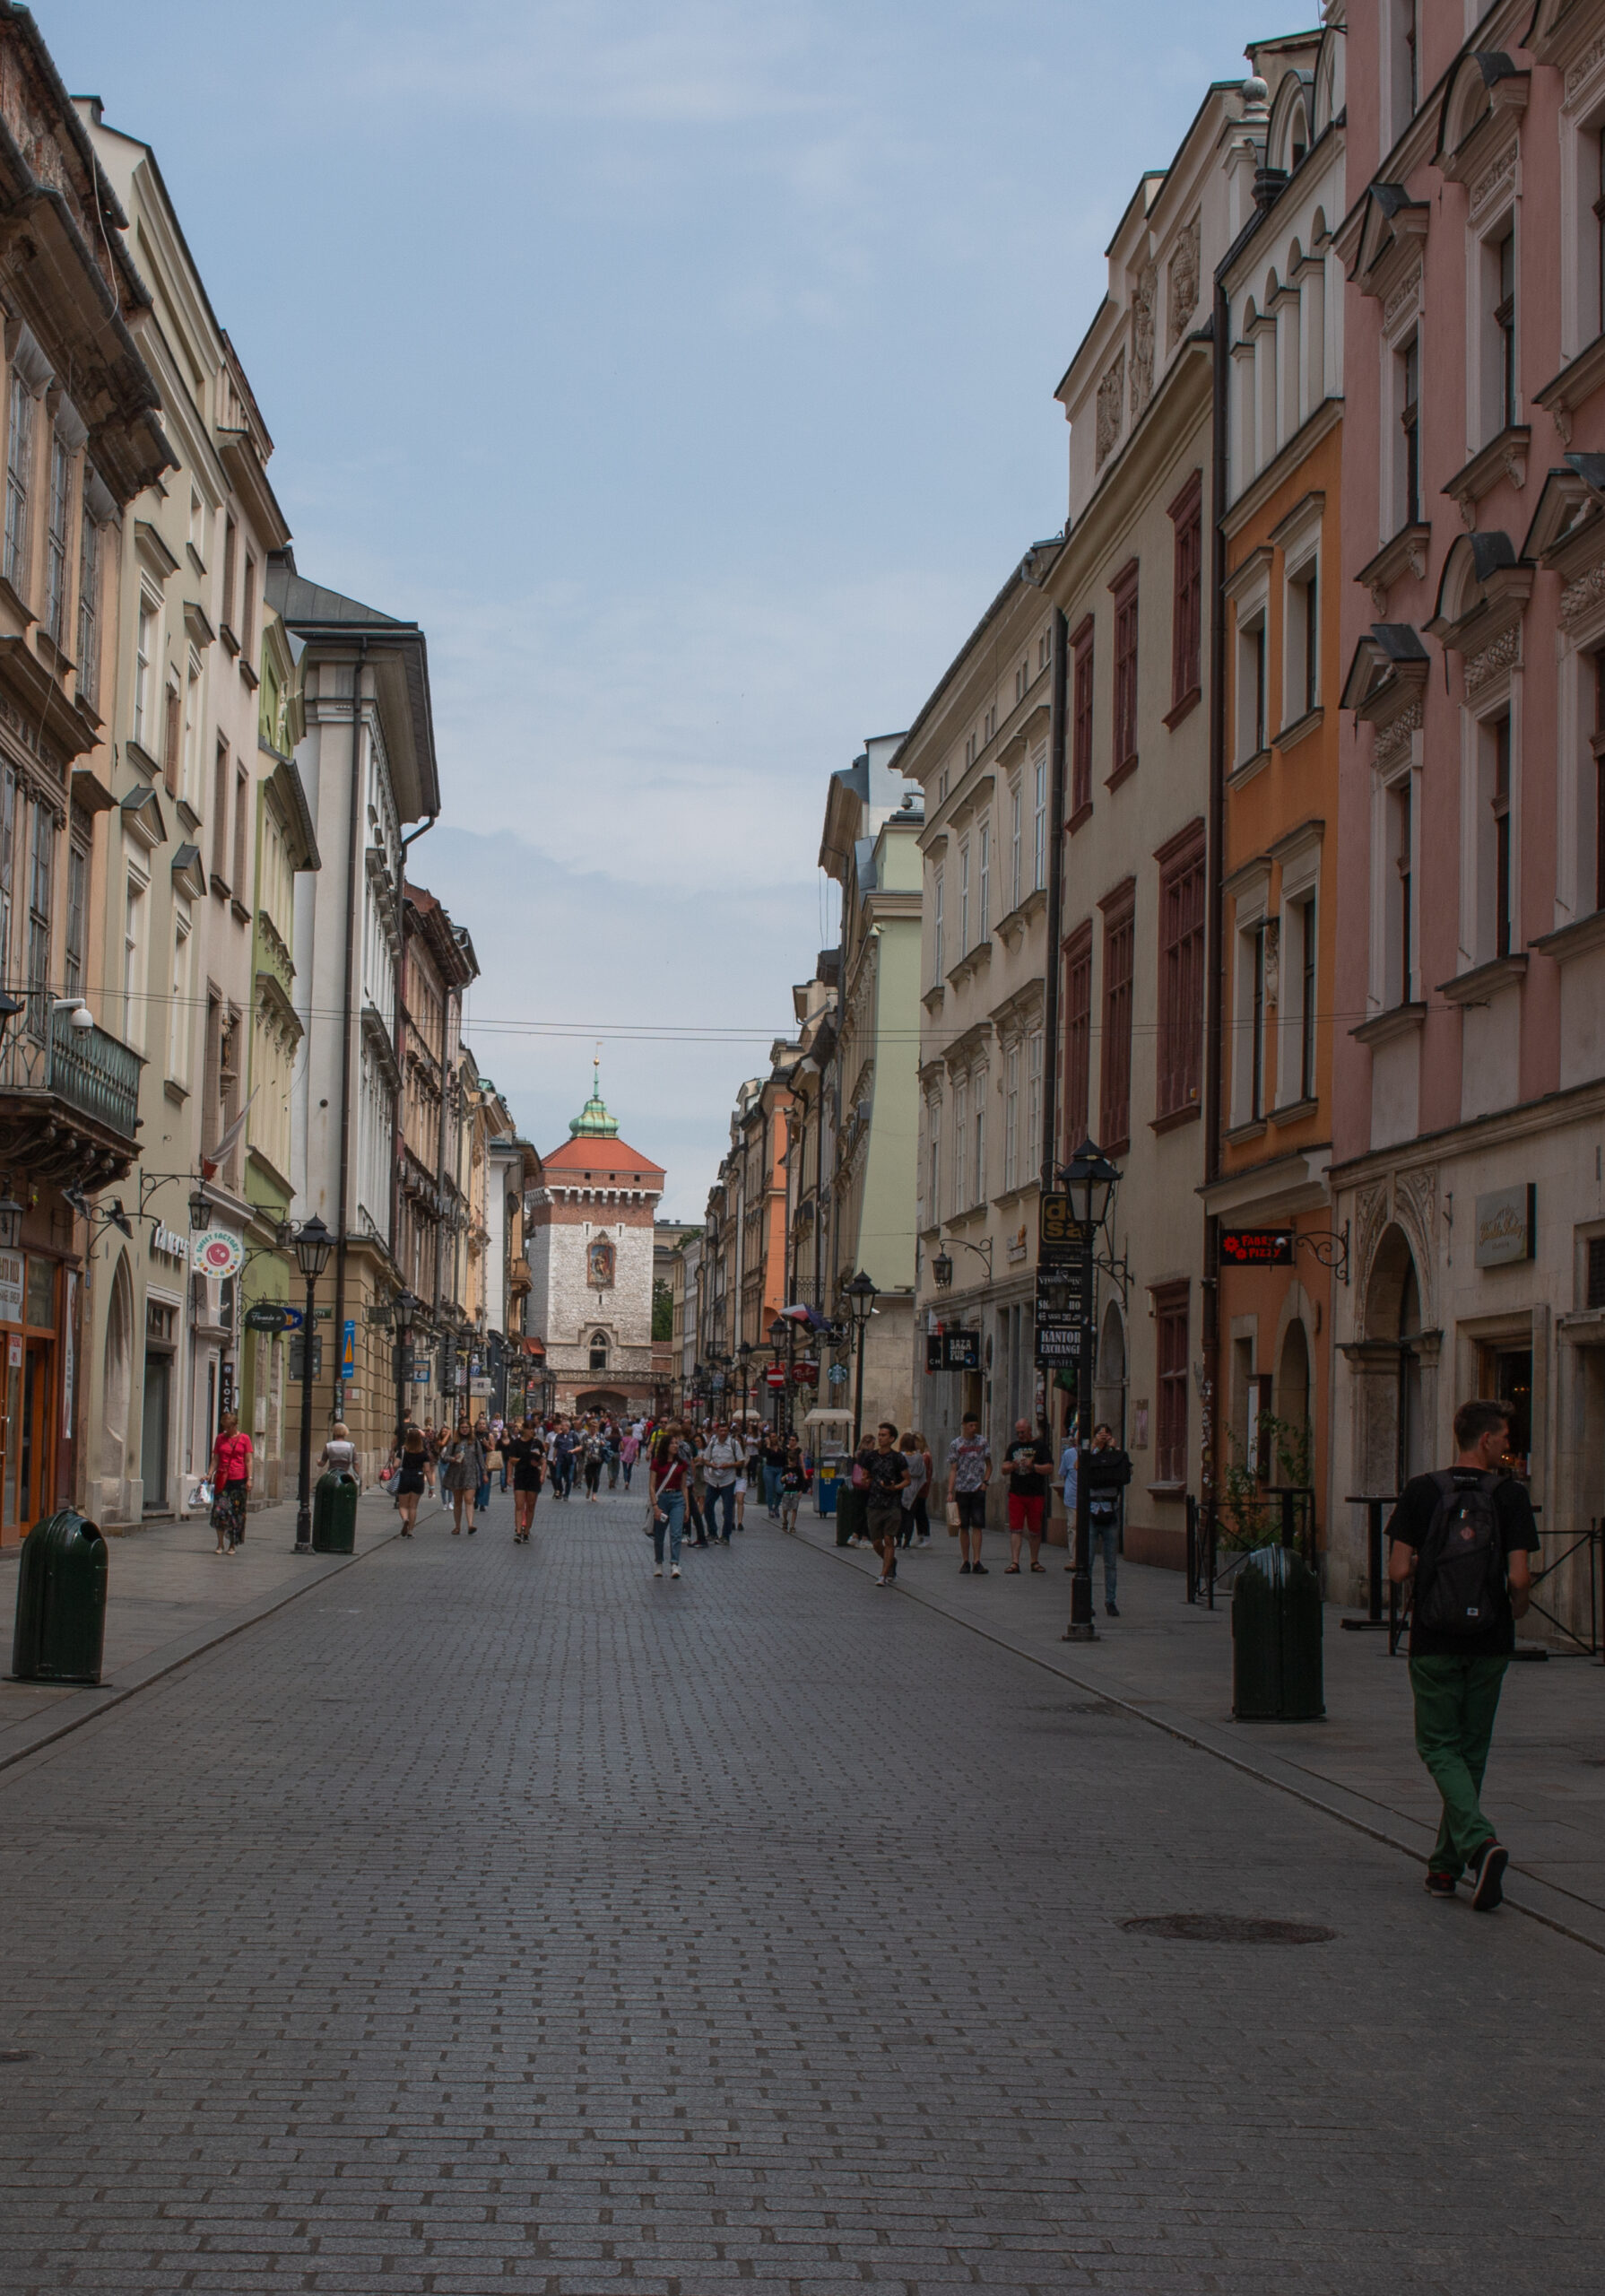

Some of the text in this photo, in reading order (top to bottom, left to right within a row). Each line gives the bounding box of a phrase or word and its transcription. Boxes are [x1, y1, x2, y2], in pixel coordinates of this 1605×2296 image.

[196, 1234, 213, 1253] SWEET
[214, 1232, 240, 1253] FACTORY
[1041, 1330, 1081, 1344] KANTOR
[950, 1339, 972, 1351] BAZA
[950, 1350, 966, 1361] PUB
[223, 1378, 231, 1413] LOCA
